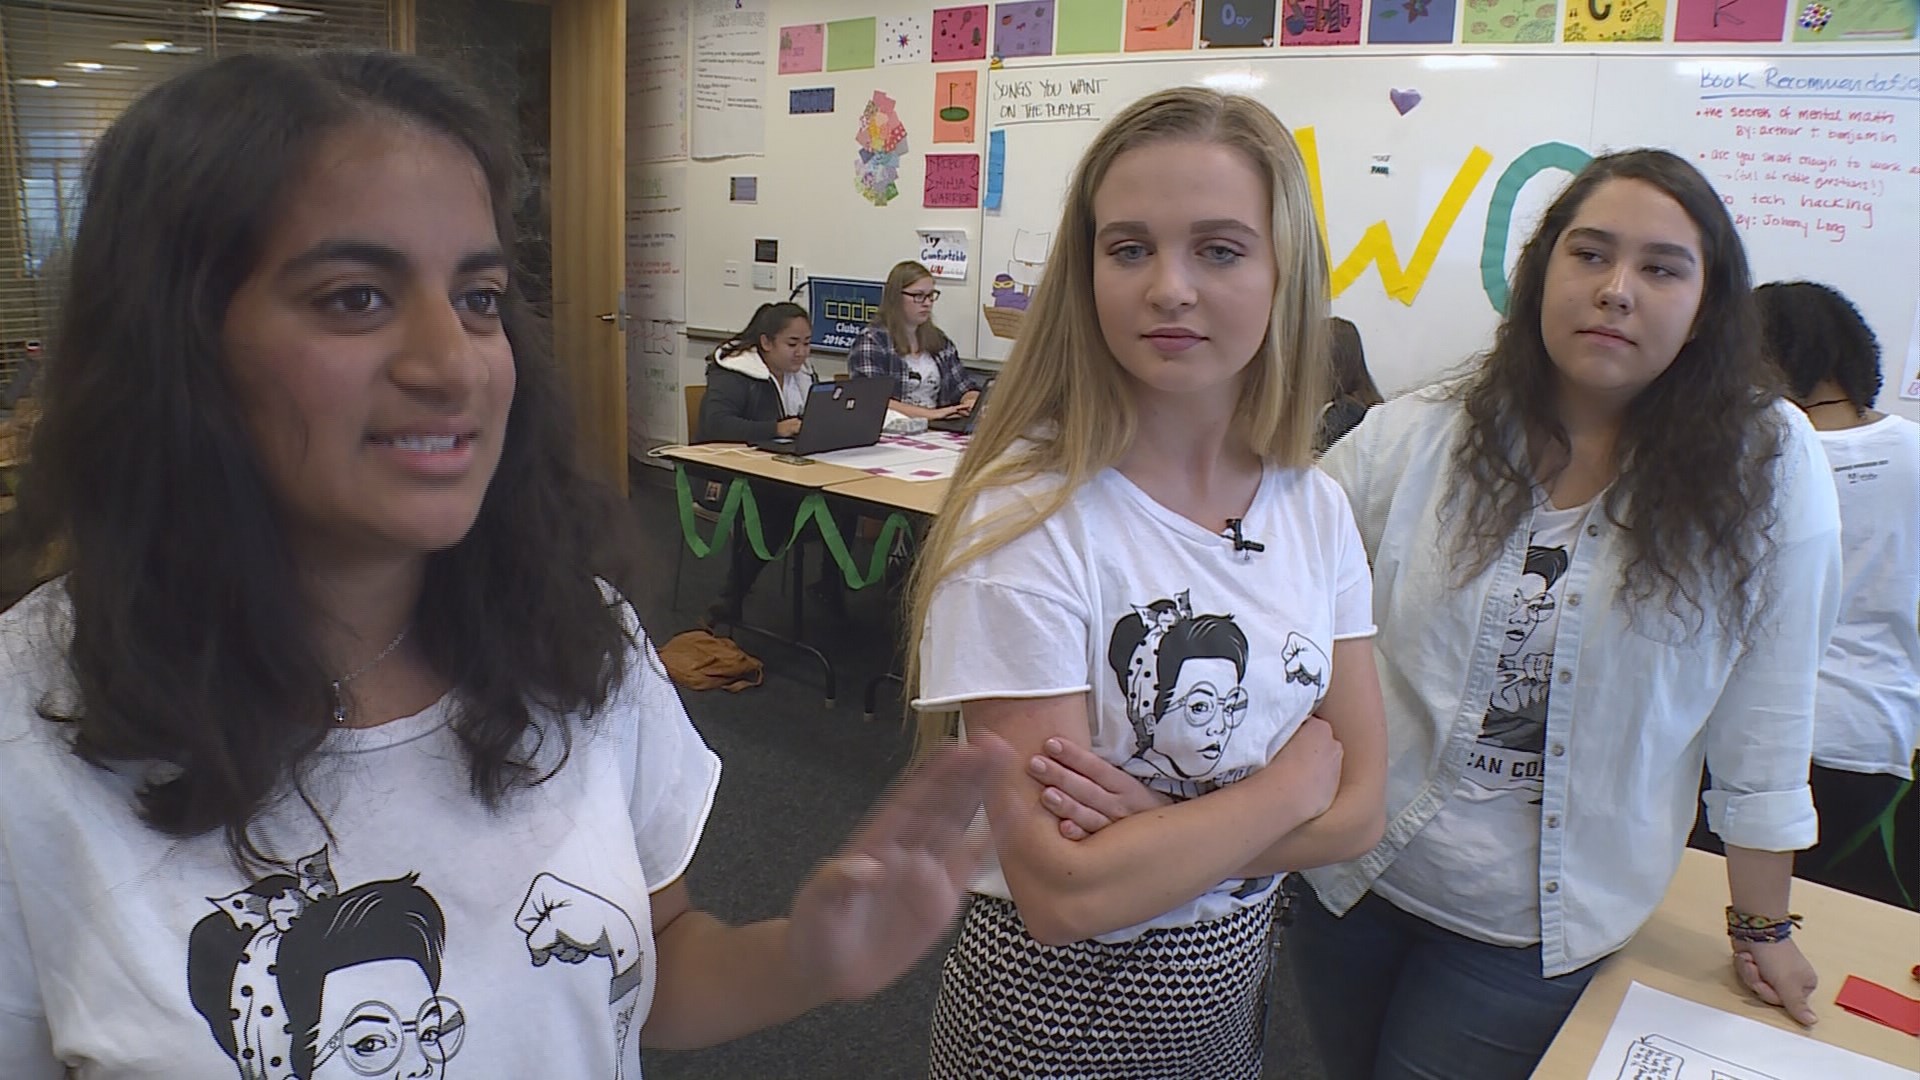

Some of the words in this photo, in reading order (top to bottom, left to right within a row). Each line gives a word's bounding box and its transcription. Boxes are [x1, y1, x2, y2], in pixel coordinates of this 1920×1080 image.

[993, 80, 1032, 101] SONGS
[1039, 78, 1062, 98] YOU
[1069, 78, 1108, 95] WANT
[1000, 103, 1016, 118] ON
[1021, 102, 1043, 118] THE
[1046, 102, 1096, 118] PLAYLIST
[1798, 106, 1843, 122] mental
[1736, 151, 1755, 168] you
[1847, 155, 1861, 168] to
[1751, 192, 1786, 206] tech
[921, 233, 941, 248] Try
[825, 298, 880, 323] code
[836, 322, 860, 335] Clubs
